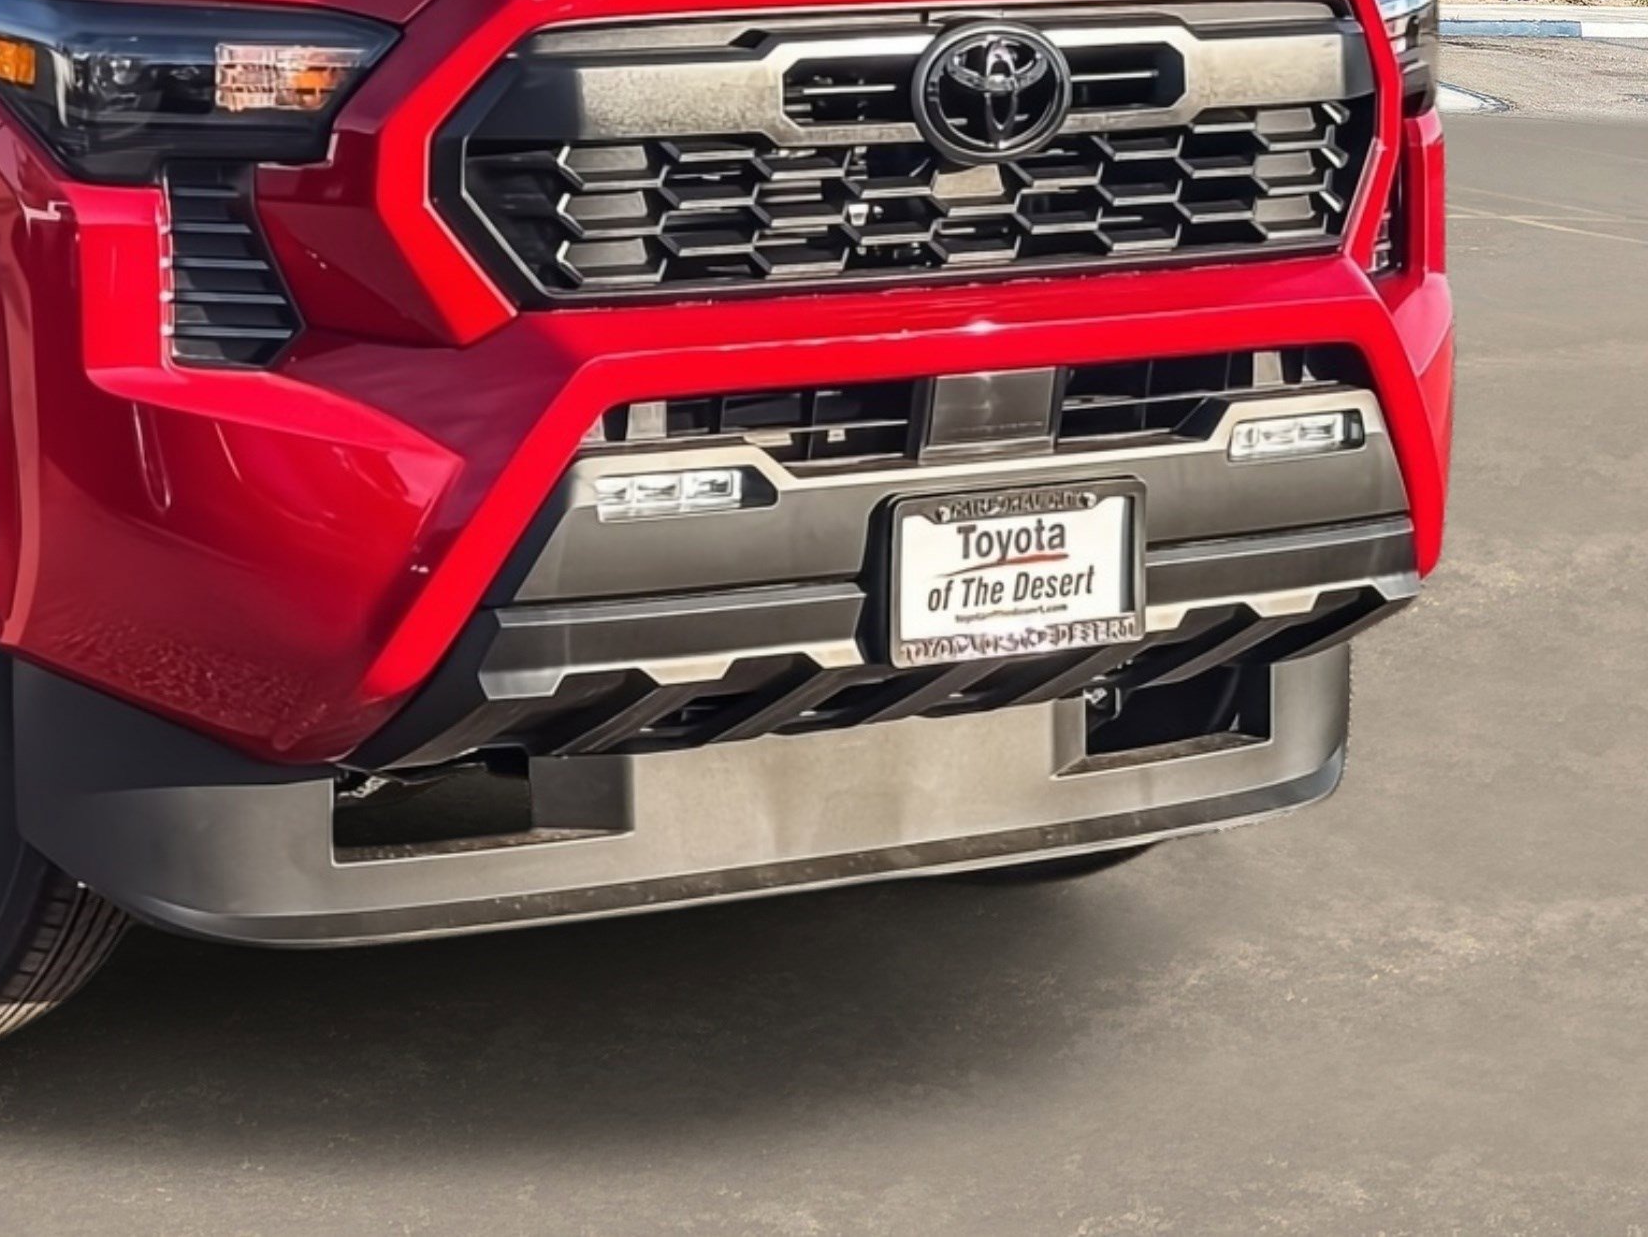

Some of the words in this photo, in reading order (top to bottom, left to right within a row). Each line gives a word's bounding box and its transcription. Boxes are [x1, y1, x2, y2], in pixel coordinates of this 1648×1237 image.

[957, 518, 1067, 561] Toyota
[927, 577, 955, 612] of
[962, 574, 1005, 608] The
[1012, 565, 1096, 602] Desert
